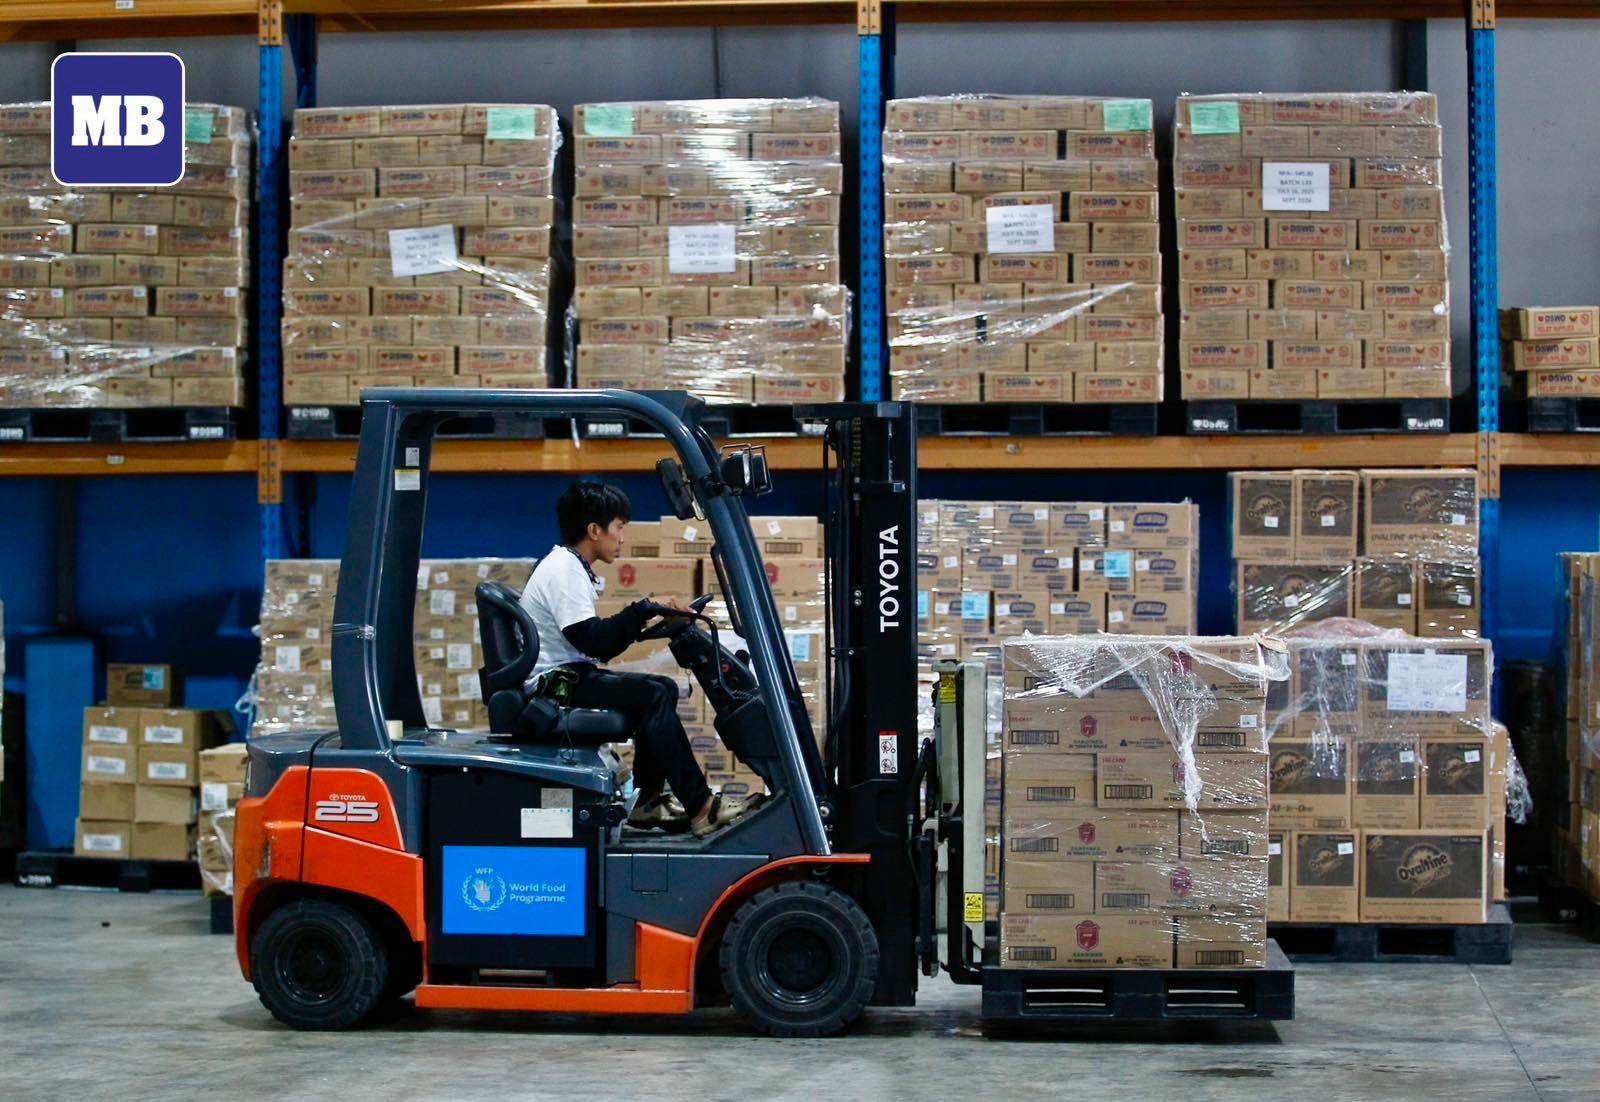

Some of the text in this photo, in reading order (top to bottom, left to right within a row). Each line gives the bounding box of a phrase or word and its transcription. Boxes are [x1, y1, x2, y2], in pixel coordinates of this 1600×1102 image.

[1535, 344, 1559, 352] DSWD
[879, 525, 900, 632] TOYOTA
[315, 801, 380, 822] 25
[1398, 852, 1448, 880] Ovaltine
[475, 868, 494, 876] WFP
[510, 884, 566, 892] World Food
[510, 894, 566, 904] Programme
